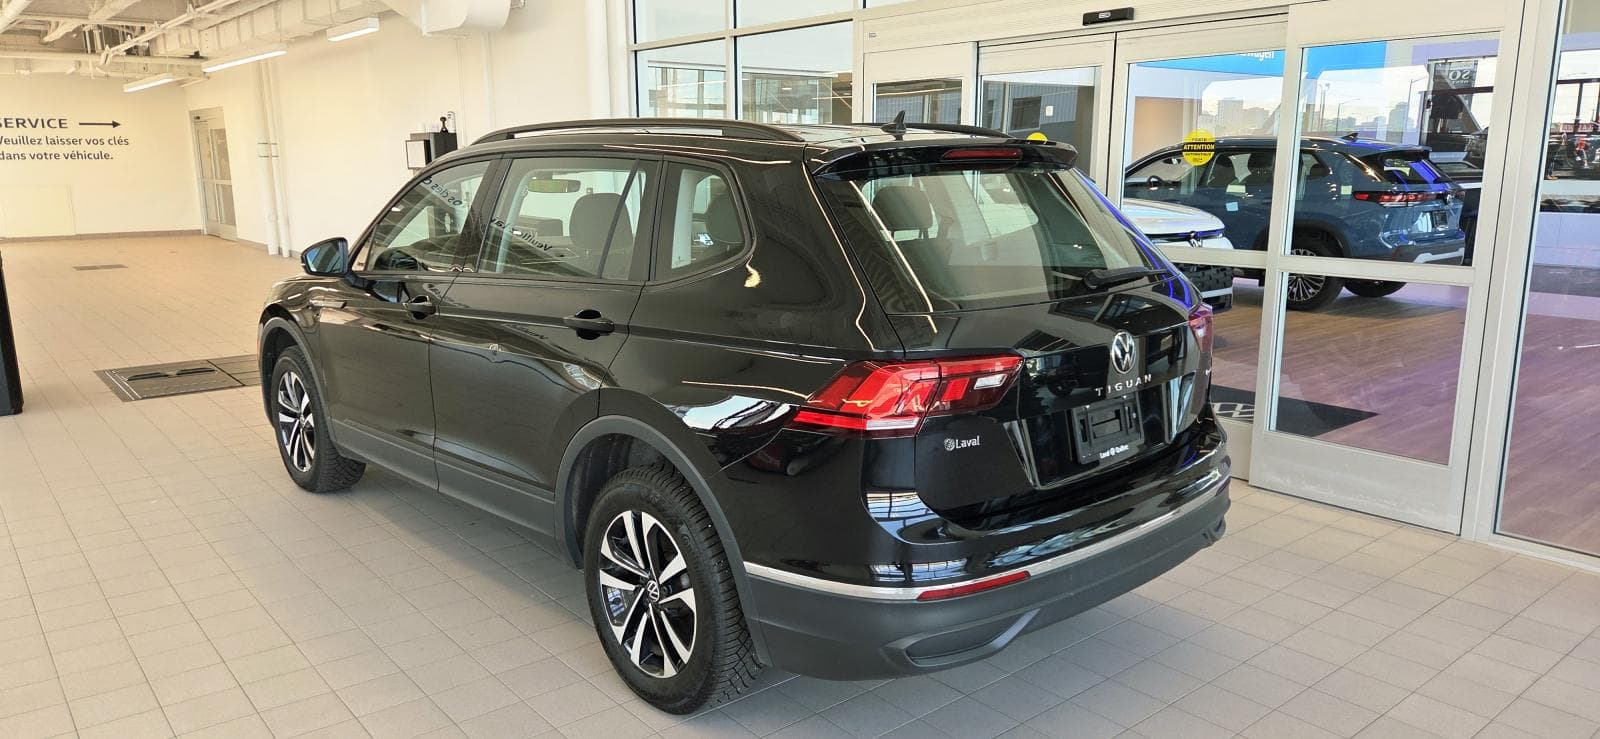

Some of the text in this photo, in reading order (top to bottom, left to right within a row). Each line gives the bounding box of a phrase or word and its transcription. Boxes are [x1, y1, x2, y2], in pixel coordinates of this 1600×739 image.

[0, 117, 69, 129] ERVICE
[45, 135, 83, 146] laisser
[85, 138, 105, 146] vos
[107, 135, 130, 146] clés
[29, 152, 61, 160] votre
[63, 150, 115, 160] véhicule.
[1094, 373, 1152, 397] TIGUAN
[955, 434, 981, 449] Laval
